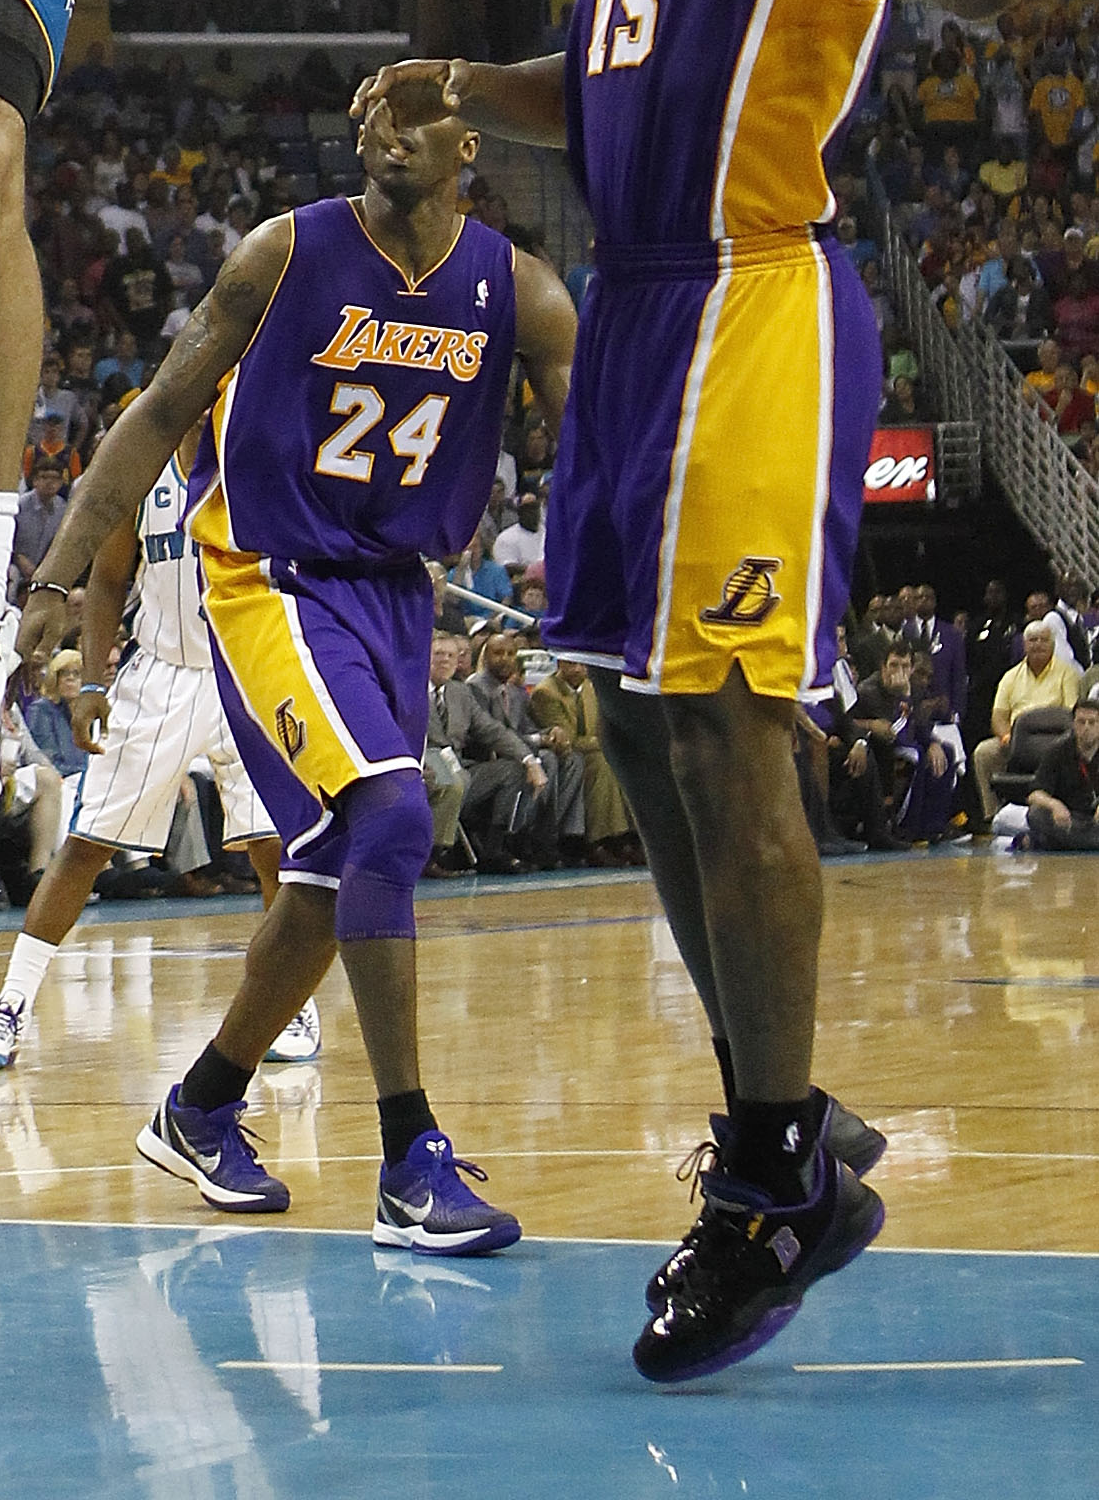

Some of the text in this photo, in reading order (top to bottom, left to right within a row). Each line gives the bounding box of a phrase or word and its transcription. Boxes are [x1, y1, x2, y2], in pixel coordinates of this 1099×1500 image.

[310, 304, 489, 382] LAKERS
[314, 381, 450, 486] 24
[154, 486, 172, 508] C
